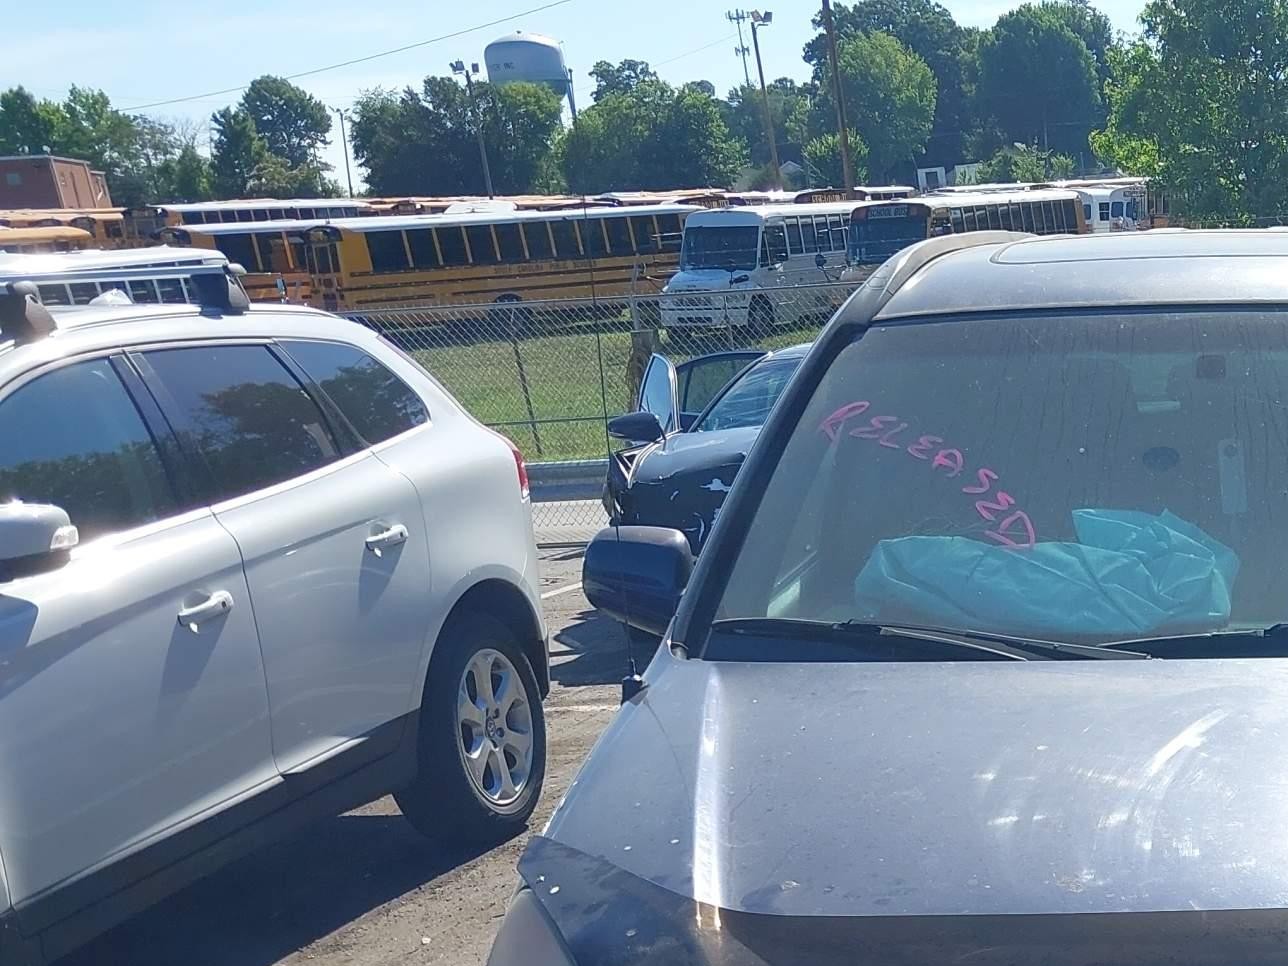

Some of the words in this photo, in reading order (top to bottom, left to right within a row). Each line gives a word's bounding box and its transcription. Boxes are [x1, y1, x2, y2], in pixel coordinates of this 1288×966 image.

[870, 207, 893, 218] SCHOOL
[894, 206, 908, 217] BUS
[820, 401, 1036, 550] RELEASED
